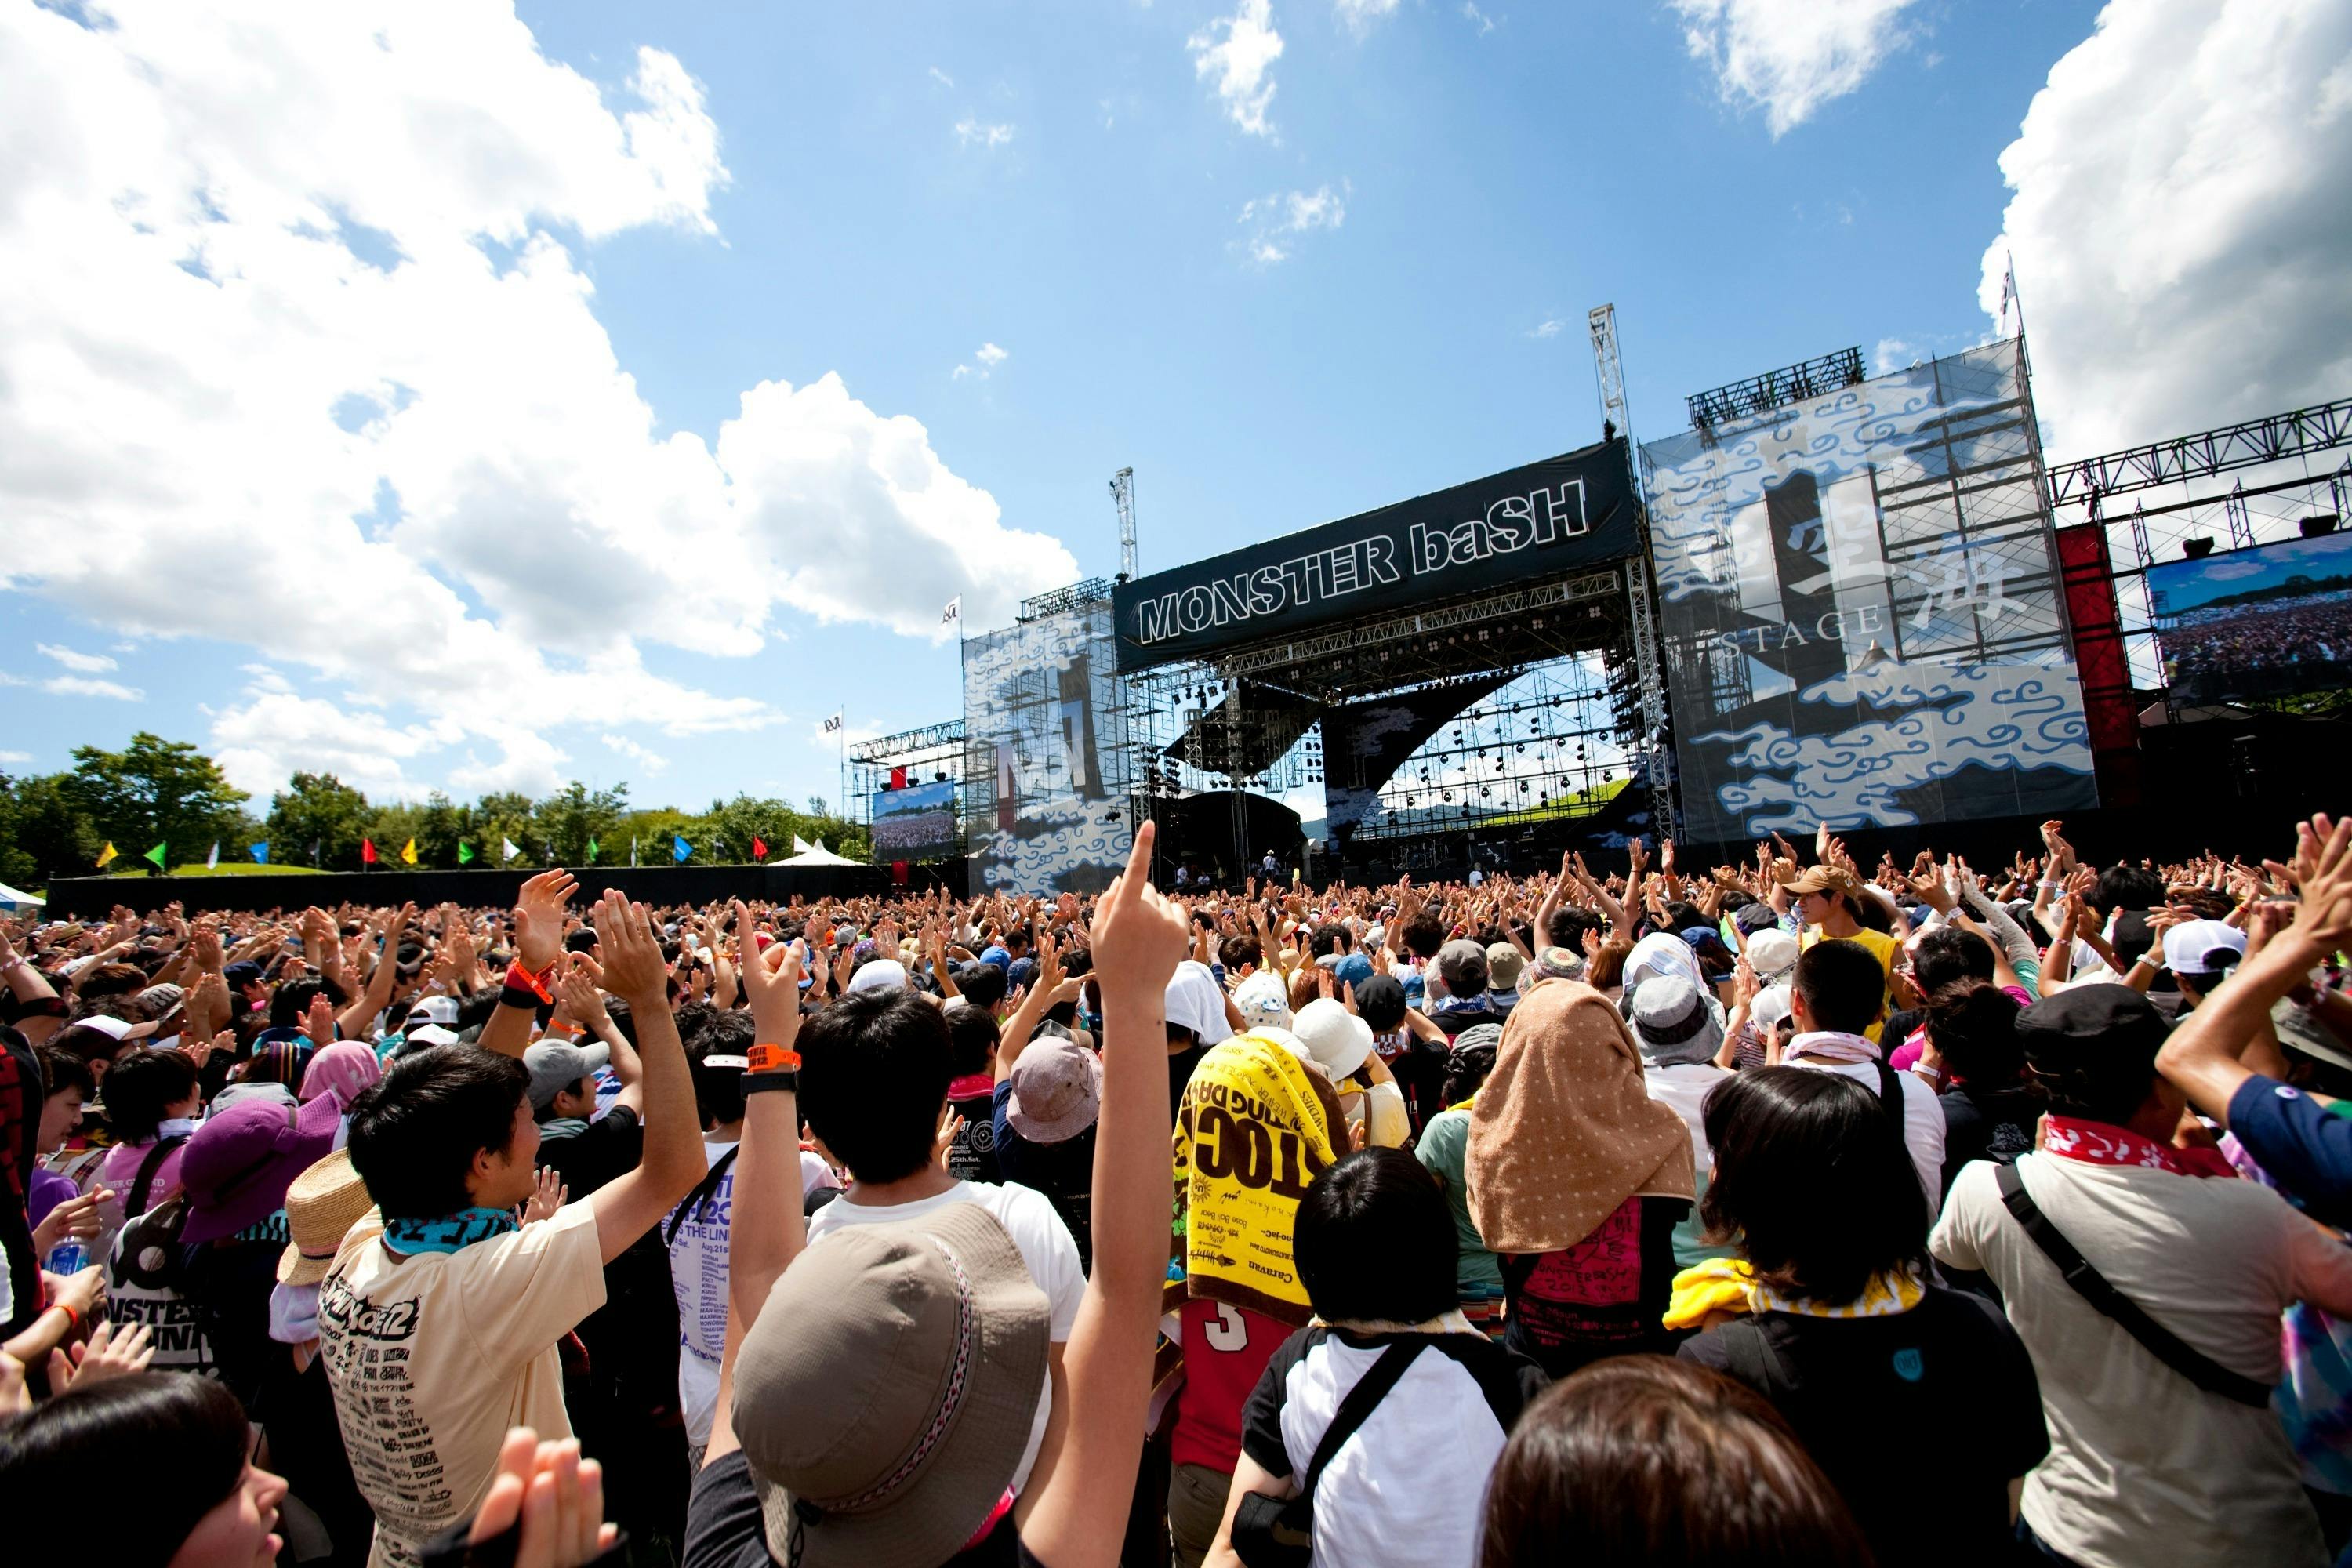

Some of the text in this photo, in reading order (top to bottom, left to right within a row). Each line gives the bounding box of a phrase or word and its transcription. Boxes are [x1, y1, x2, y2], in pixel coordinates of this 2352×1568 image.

[1138, 480, 1588, 644] MONSTER baSH
[1720, 604, 1882, 659] STAGE
[1200, 1210, 1216, 1220] Bear
[1232, 1216, 1247, 1229] Base
[685, 1225, 707, 1239] THE
[709, 1229, 730, 1241] LIN
[702, 1242, 728, 1254] Aug.21s
[1248, 1261, 1293, 1283] Caravan
